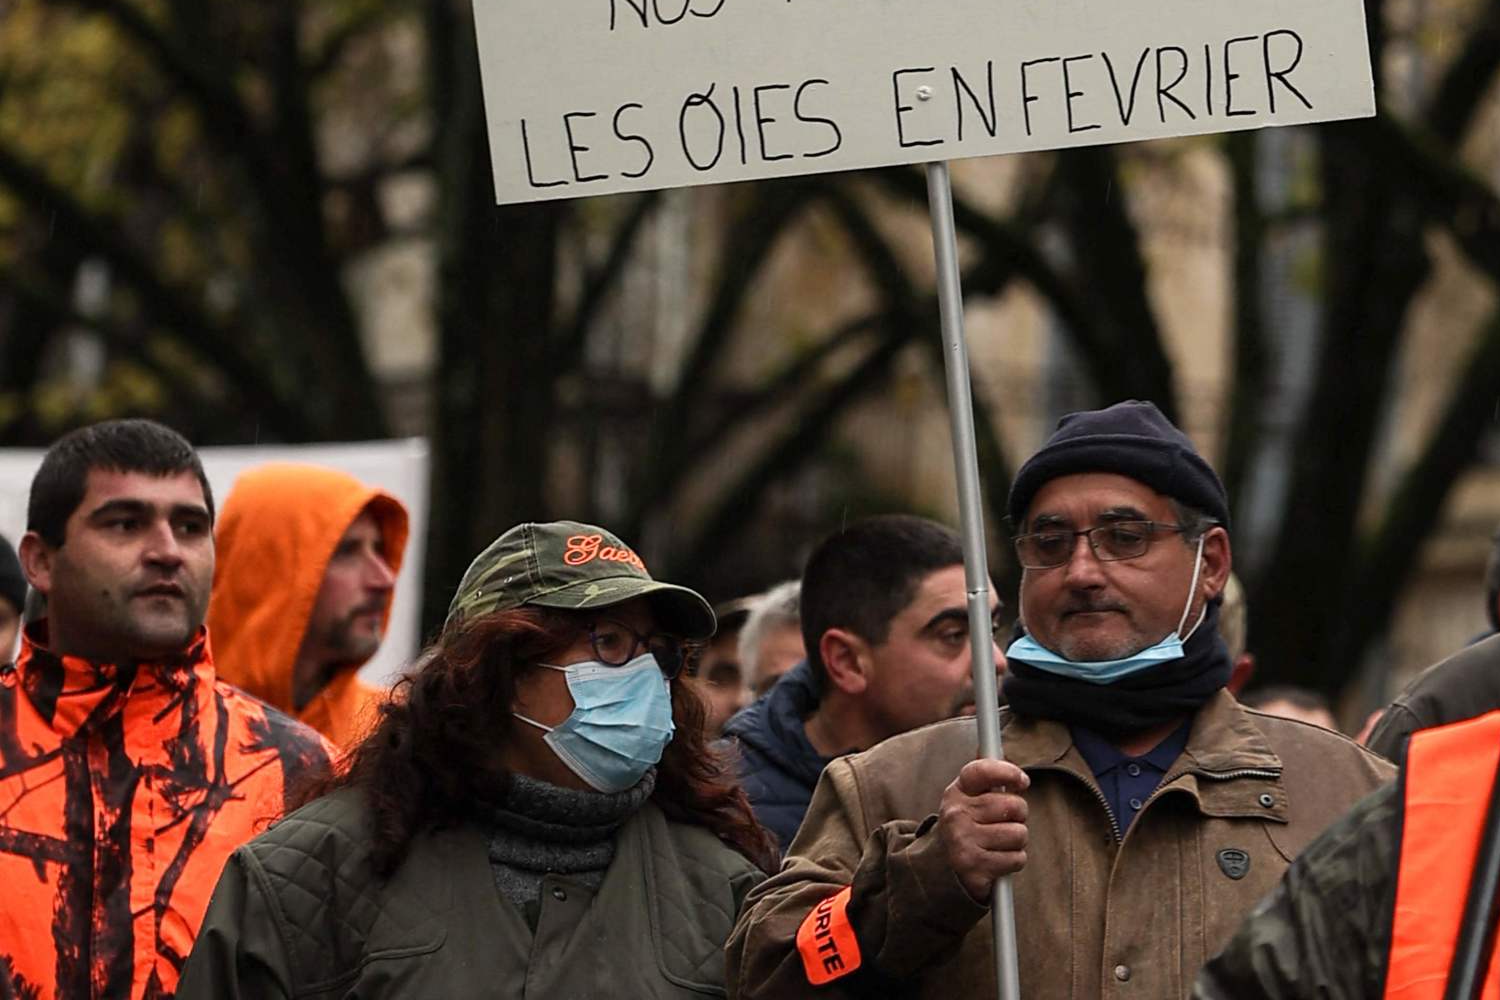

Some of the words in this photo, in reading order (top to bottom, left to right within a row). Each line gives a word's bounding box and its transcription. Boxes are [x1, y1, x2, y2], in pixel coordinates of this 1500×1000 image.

[520, 102, 654, 188] LES
[678, 78, 842, 172] OIES
[892, 60, 997, 148] EN
[1020, 29, 1313, 136] FEVRIER
